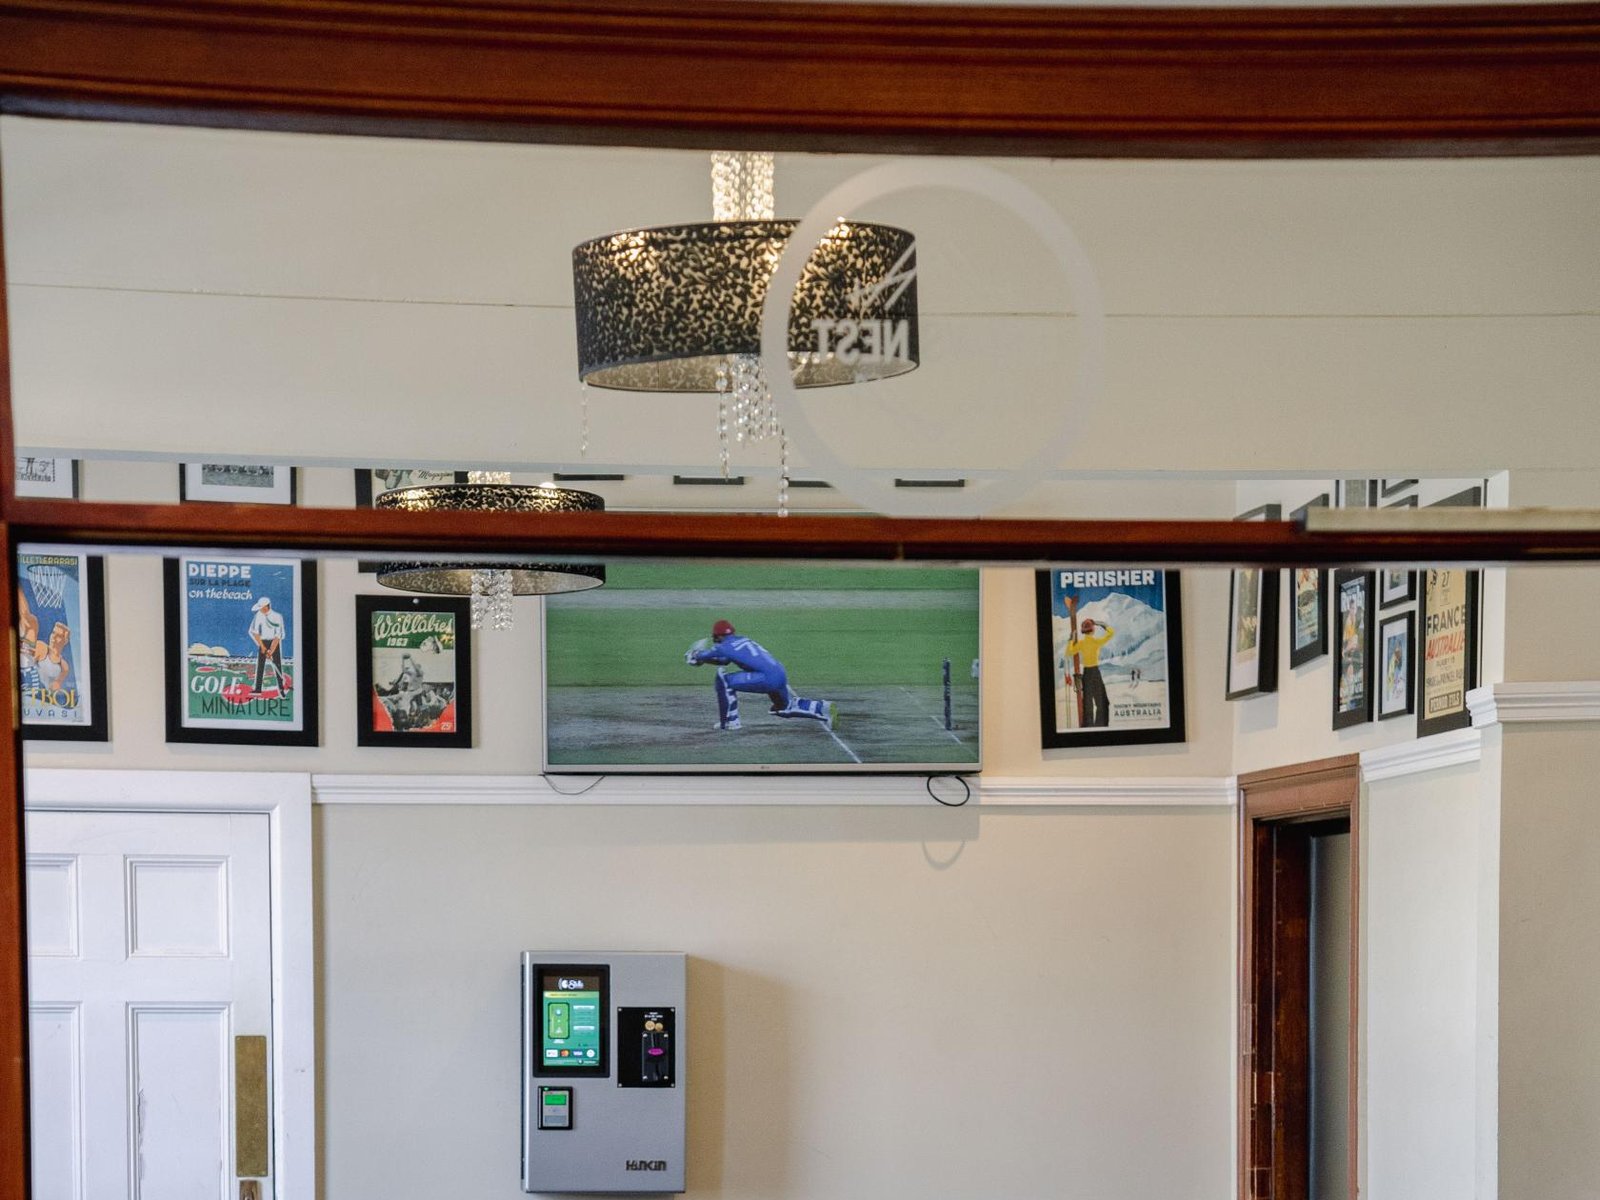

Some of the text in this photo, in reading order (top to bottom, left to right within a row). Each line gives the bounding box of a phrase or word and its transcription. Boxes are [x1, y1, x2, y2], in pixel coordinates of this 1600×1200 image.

[188, 563, 252, 579] DIEPPE
[1060, 569, 1155, 588] PERISHER
[208, 579, 219, 587] LA
[221, 579, 252, 588] PLAGE
[188, 590, 204, 599] on
[374, 614, 453, 641] Wallabies
[1426, 605, 1466, 637] FRANCE
[191, 675, 244, 695] GOLF
[202, 696, 291, 717] MINIATURE
[1114, 708, 1162, 717] AUSTRALIA
